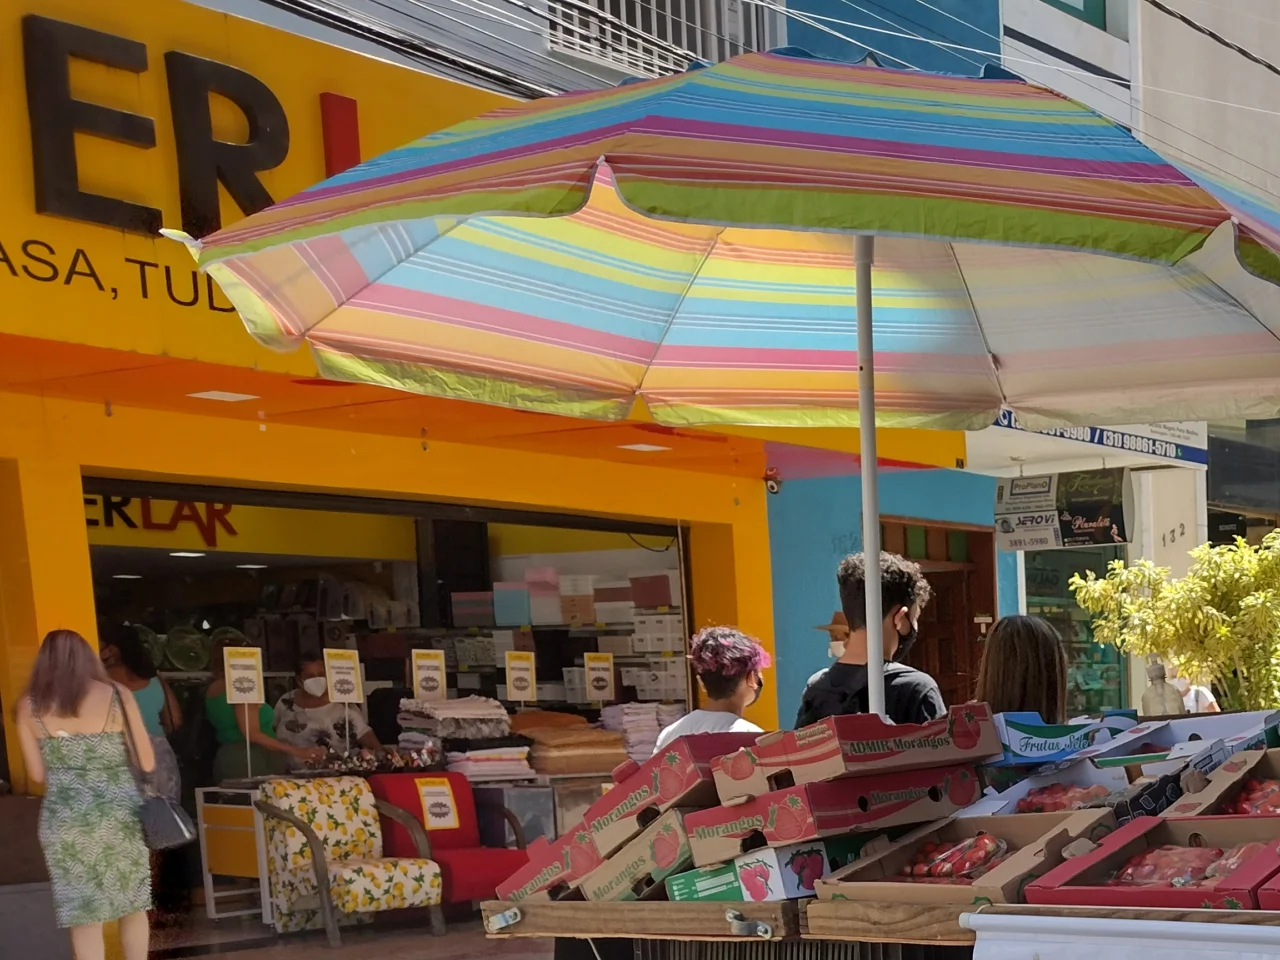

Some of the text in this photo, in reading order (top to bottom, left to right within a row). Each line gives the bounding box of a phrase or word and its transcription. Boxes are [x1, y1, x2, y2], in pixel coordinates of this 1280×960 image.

[1123, 434, 1177, 458] 98861-5710
[892, 736, 950, 752] Morangos
[1019, 736, 1061, 752] Frutas
[869, 787, 928, 803] Morangos
[591, 785, 650, 833] Morangos
[693, 814, 764, 840] Morangos
[509, 861, 562, 901] Morangos
[592, 855, 646, 900] Morangos
